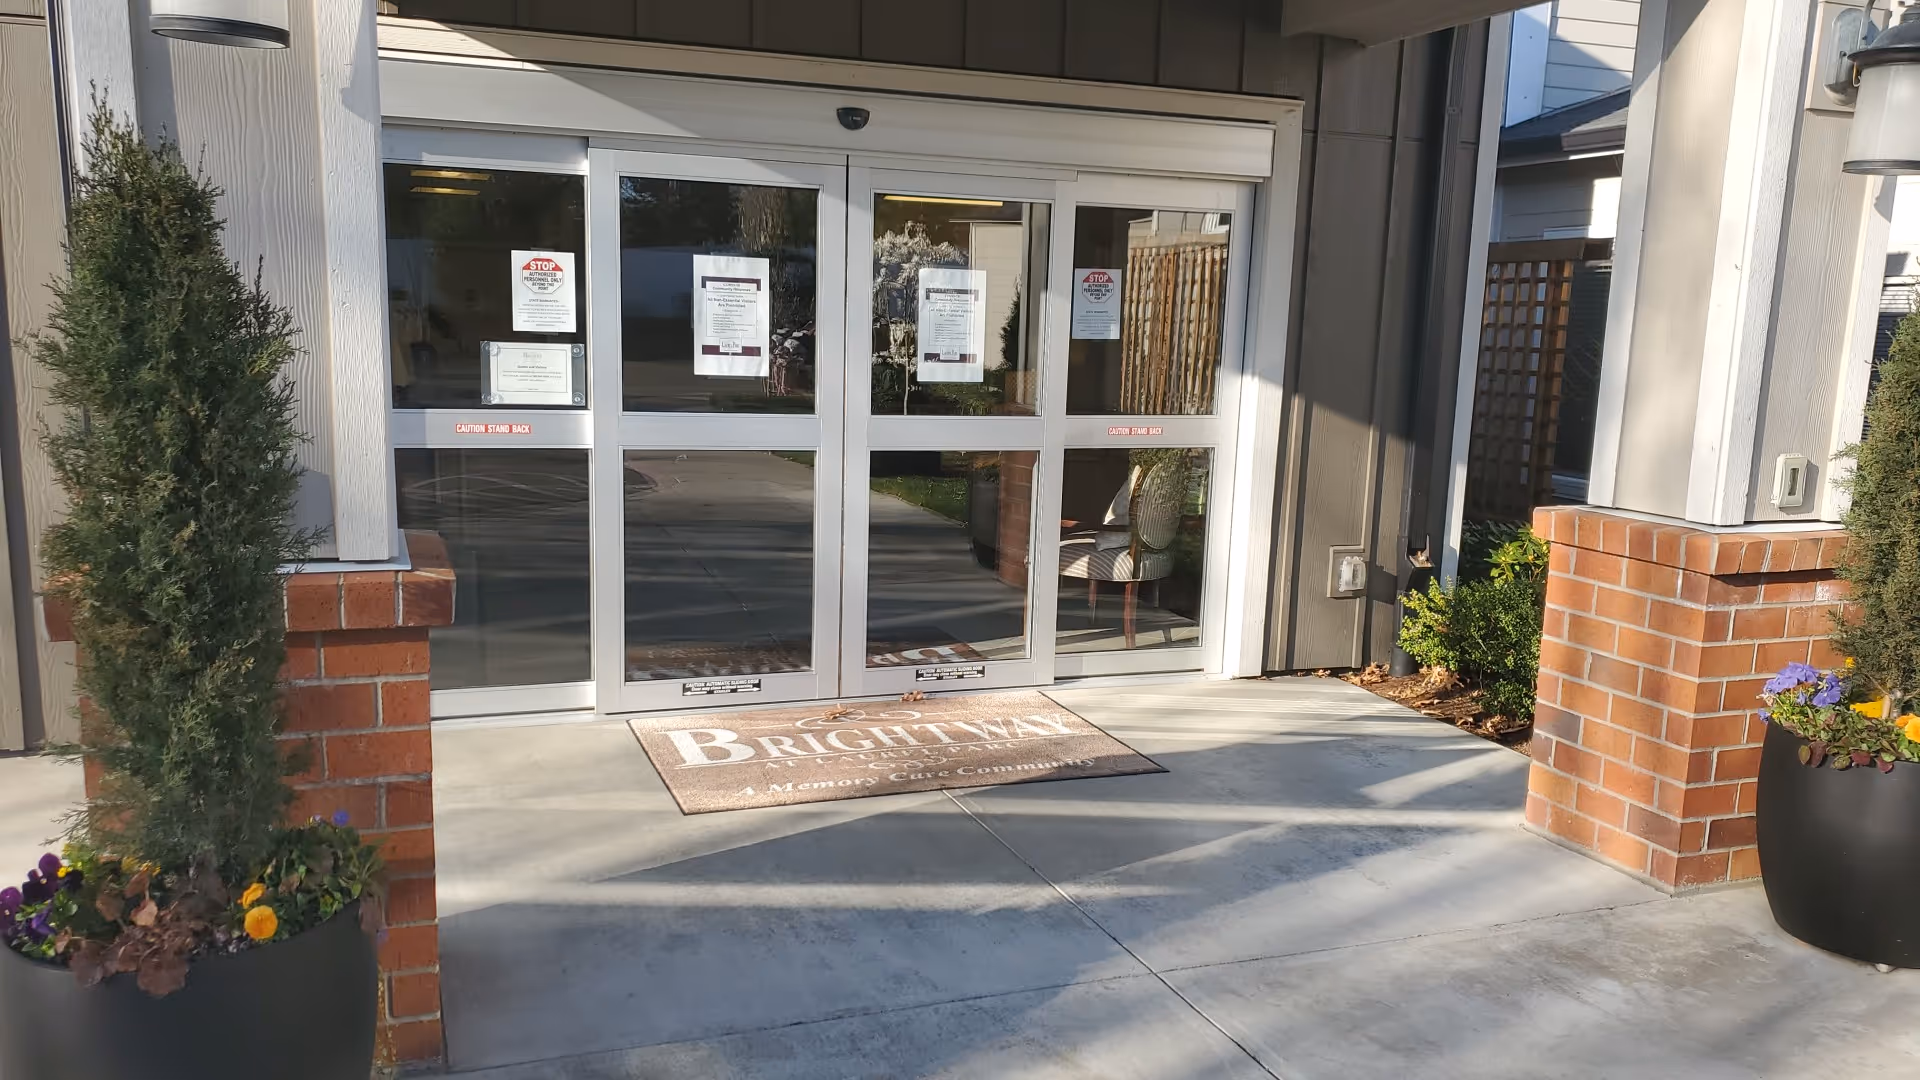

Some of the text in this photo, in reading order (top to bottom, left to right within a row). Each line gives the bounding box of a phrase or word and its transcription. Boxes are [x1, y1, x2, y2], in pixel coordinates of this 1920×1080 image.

[530, 260, 556, 271] STOP
[1089, 274, 1109, 283] STOP
[456, 424, 530, 433] CAUTION STAND BACK
[1109, 427, 1162, 435] CAUTION STAND BACK
[656, 713, 1073, 767] BRIGHTWAY
[951, 741, 1019, 753] PARC
[735, 757, 1096, 797] A Memory Care Community
